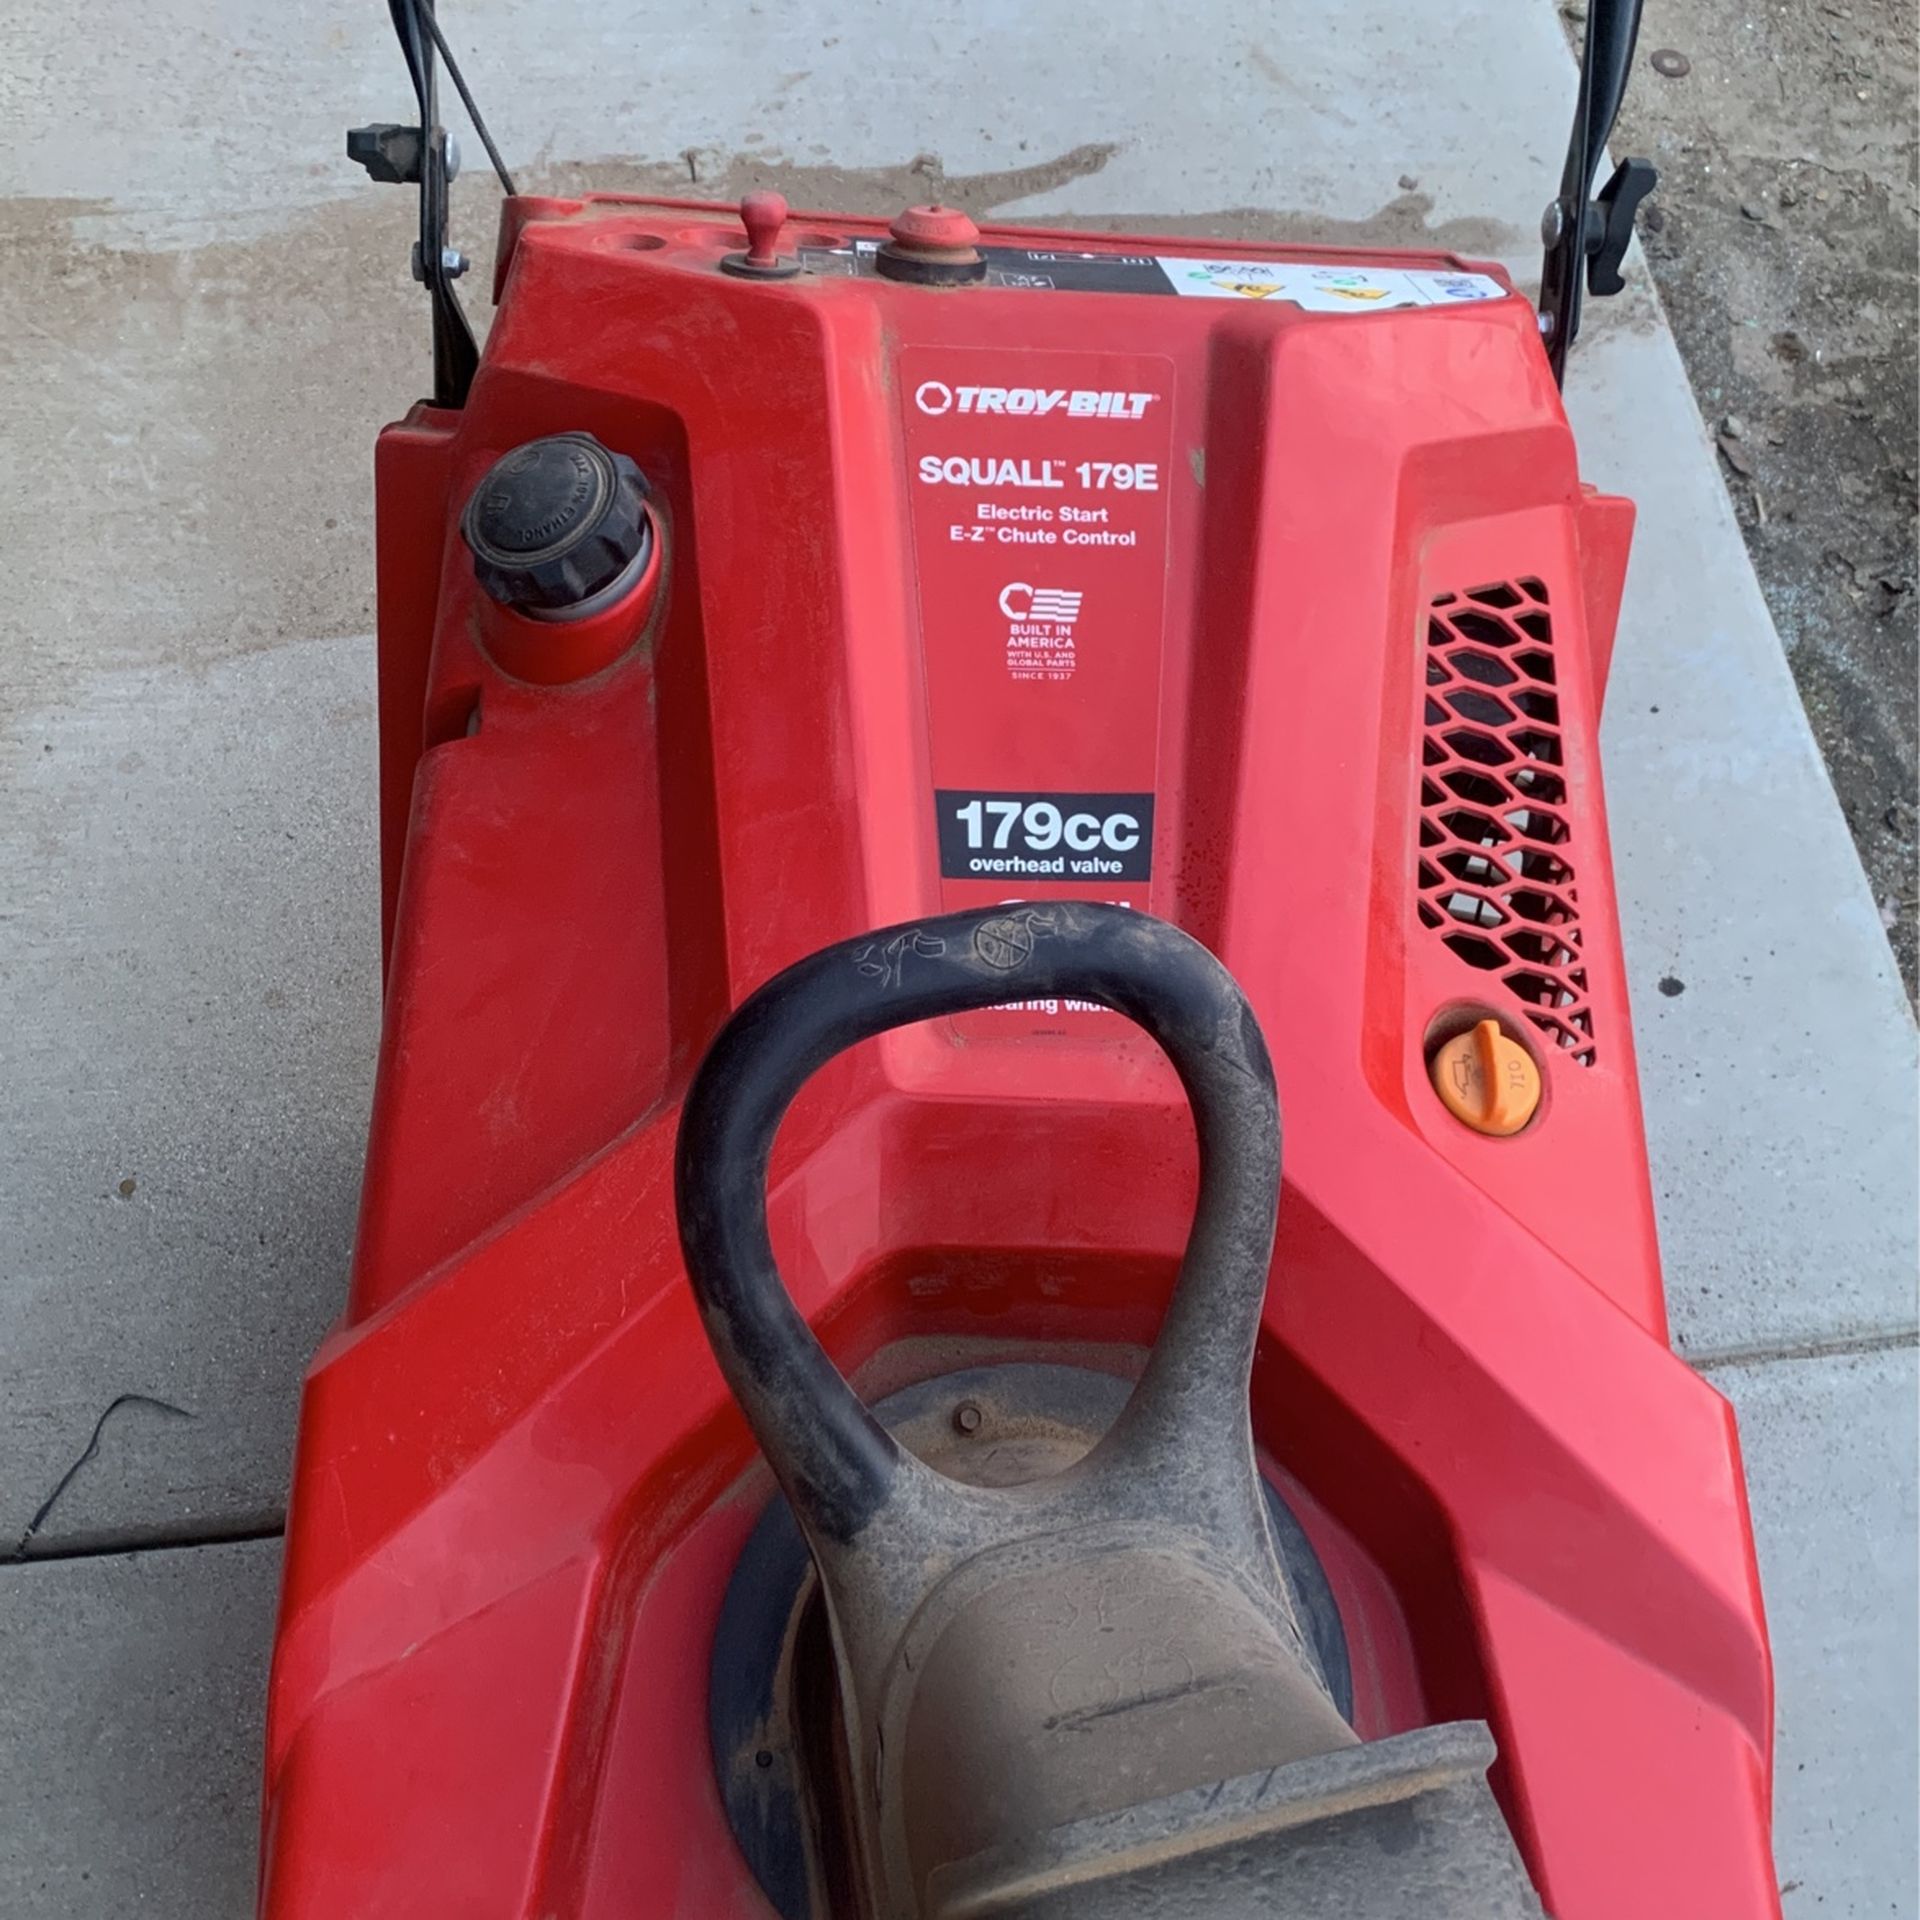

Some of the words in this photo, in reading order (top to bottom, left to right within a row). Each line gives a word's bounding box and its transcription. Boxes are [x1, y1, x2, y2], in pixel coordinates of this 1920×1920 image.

[1075, 461, 1159, 491] 179E
[976, 503, 1054, 522] Electric
[1058, 505, 1109, 523] Start
[997, 526, 1058, 545] Chute
[1062, 528, 1137, 546] Control
[1010, 624, 1052, 636] BUILT
[1055, 624, 1072, 637] IN
[1006, 636, 1076, 649] AMERICA
[1006, 658, 1045, 667] GLOBAL
[1045, 658, 1076, 668] PARTS
[1007, 650, 1032, 659] WITH
[1054, 651, 1076, 660] AND
[1011, 671, 1044, 680] SINCE
[1047, 672, 1072, 681] 1937
[956, 800, 1140, 851] 179cc
[969, 855, 1065, 874] overhead
[1070, 856, 1124, 874] valve
